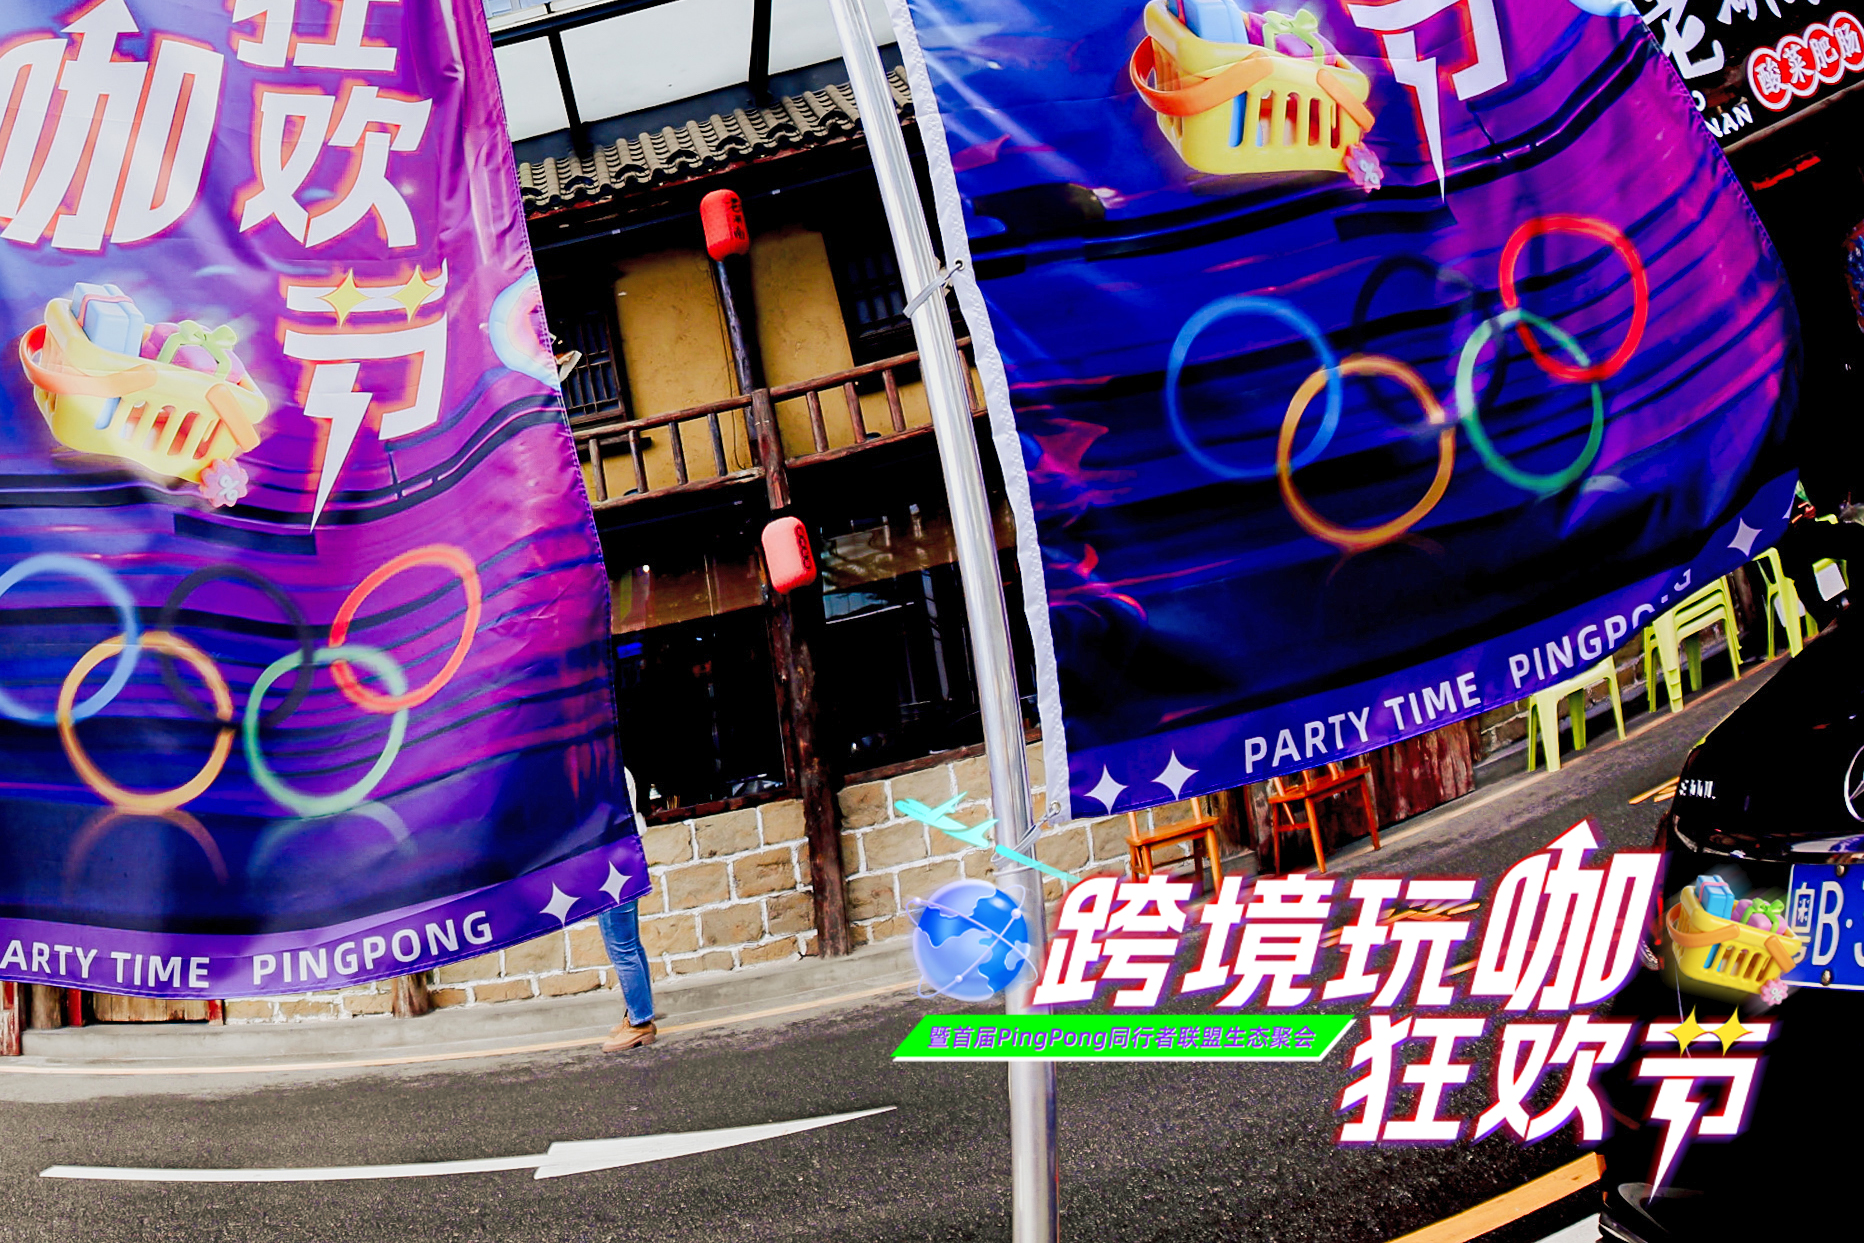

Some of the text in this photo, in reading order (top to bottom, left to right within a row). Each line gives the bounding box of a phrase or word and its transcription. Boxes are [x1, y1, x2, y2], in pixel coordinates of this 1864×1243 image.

[1754, 21, 1863, 96] 酸菜肥肠
[1242, 705, 1372, 775] PARTY
[1383, 669, 1482, 732] TIME
[110, 949, 210, 990] TIME
[251, 908, 495, 988] PINGPONG
